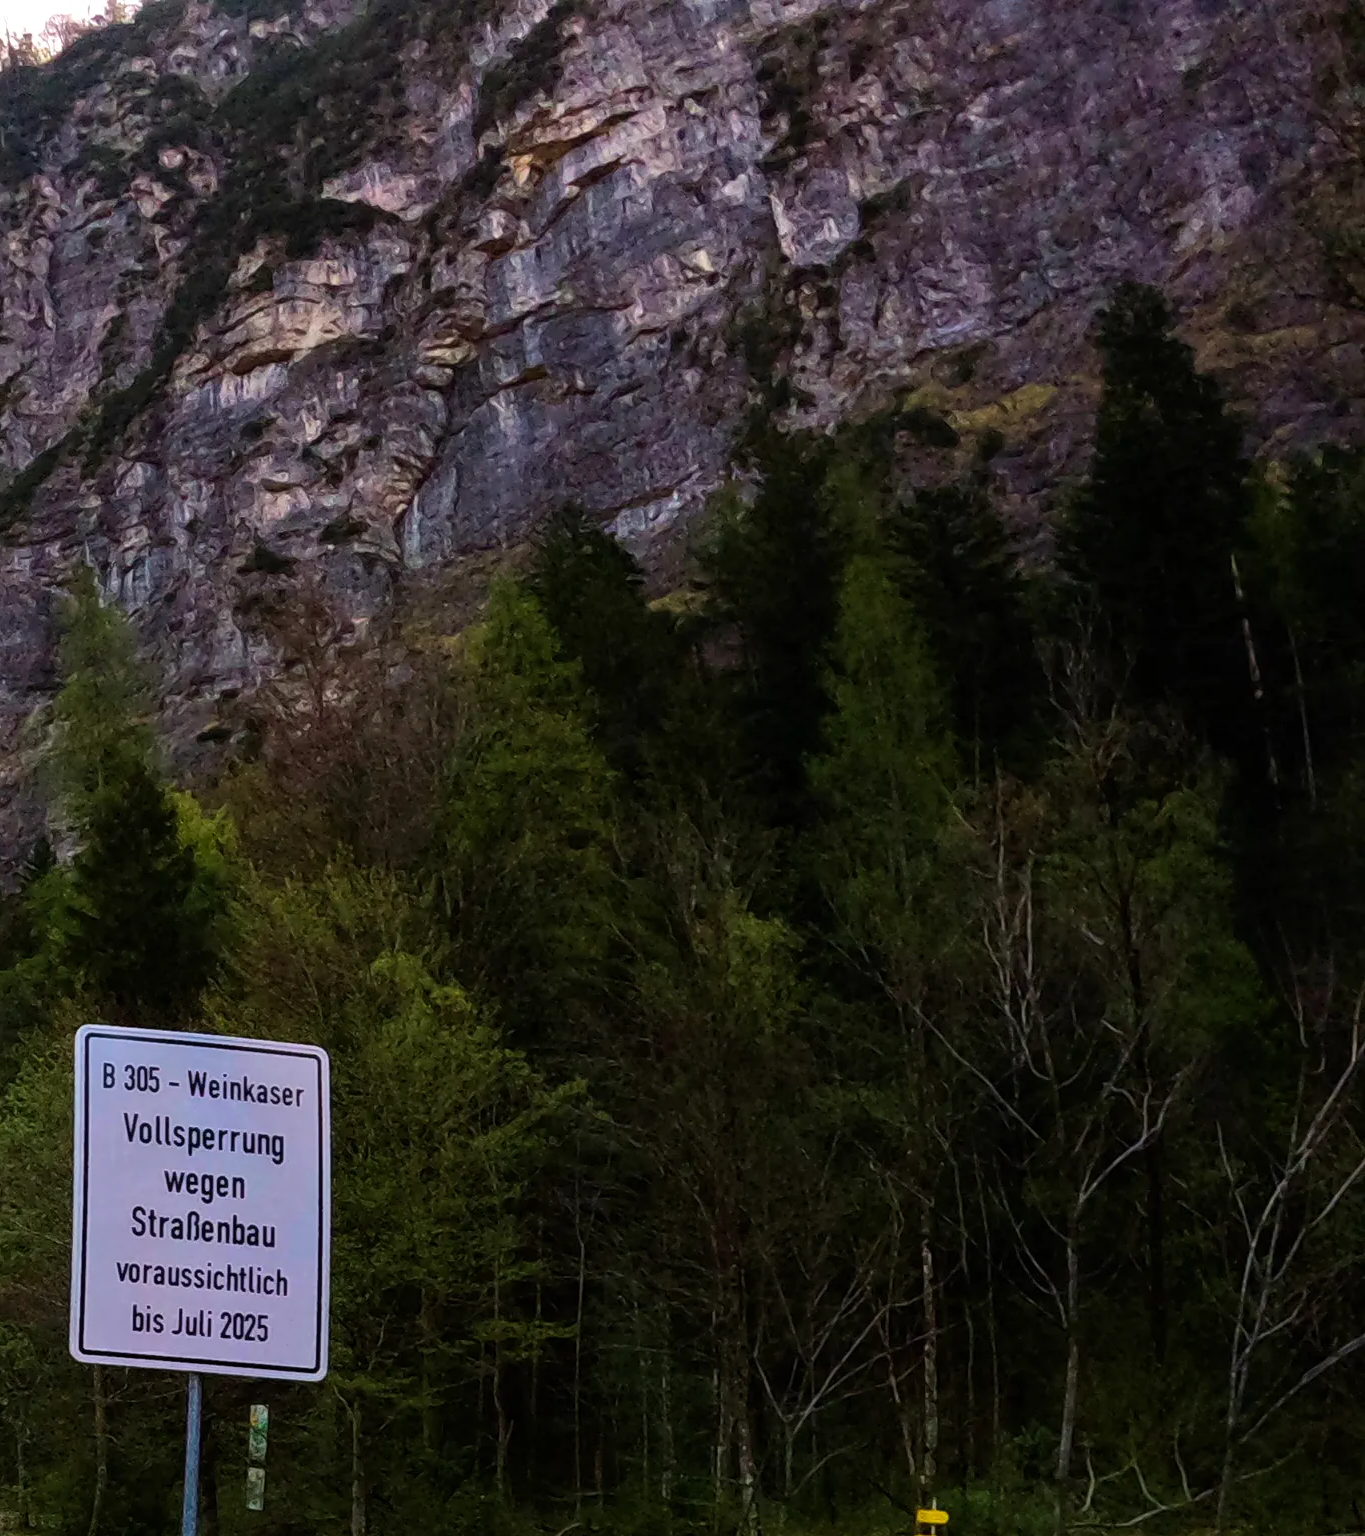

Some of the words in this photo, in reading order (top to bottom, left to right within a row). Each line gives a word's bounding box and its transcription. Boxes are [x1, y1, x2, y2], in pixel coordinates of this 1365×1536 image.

[102, 1062, 115, 1089] B
[123, 1064, 160, 1094] 305
[187, 1069, 305, 1108] Weinkaser
[123, 1112, 285, 1166] Vollsperrung
[163, 1170, 246, 1205] wegen
[131, 1205, 276, 1249] Straßenbau
[116, 1261, 288, 1297] voraussichtlich
[131, 1303, 165, 1335] bis
[171, 1307, 213, 1340] Juli
[219, 1311, 269, 1343] 2025
